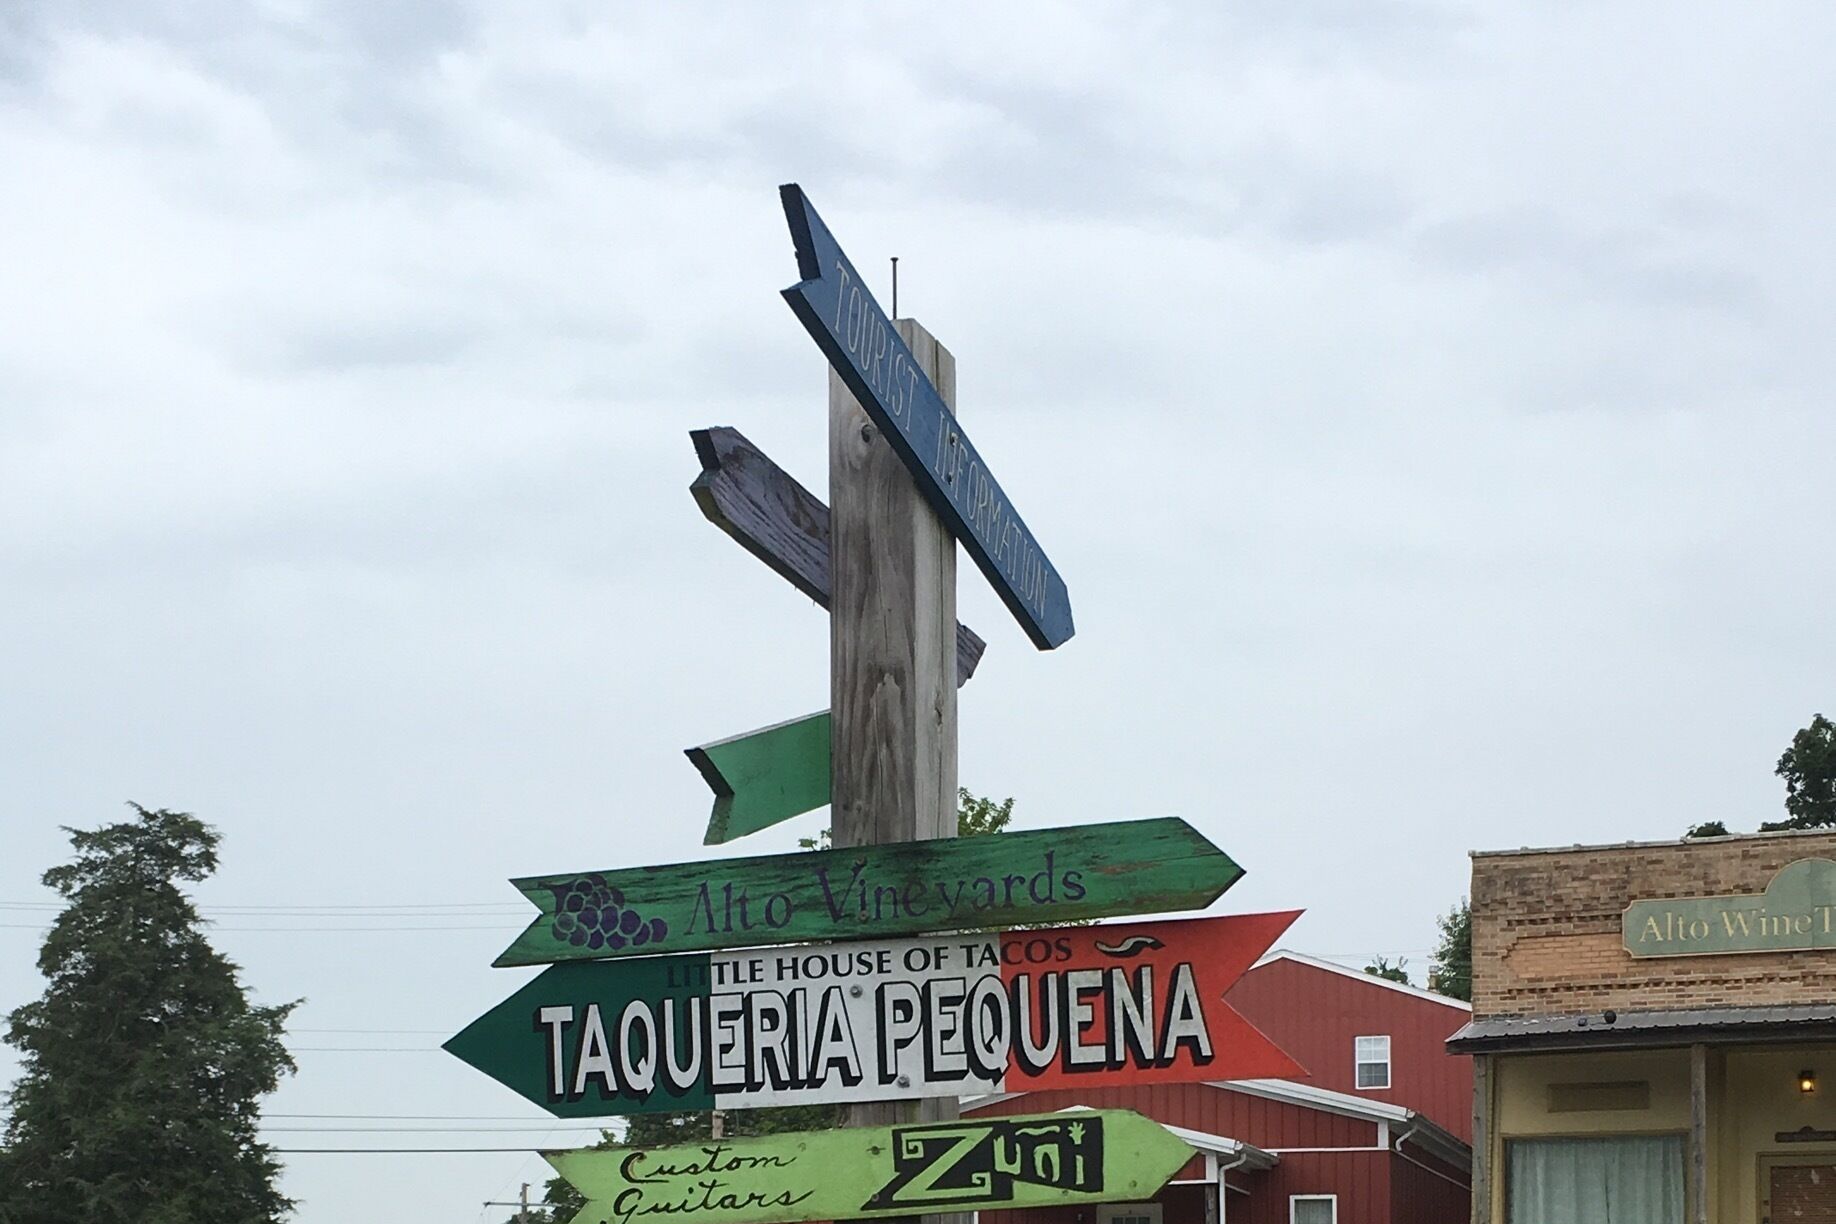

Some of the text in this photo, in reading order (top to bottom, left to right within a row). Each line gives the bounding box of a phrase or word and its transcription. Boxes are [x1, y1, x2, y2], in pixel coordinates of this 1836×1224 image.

[834, 261, 919, 432] TOURIST
[935, 411, 1048, 619] INFORMATION
[683, 849, 1087, 936] Alto Vineyards
[1640, 911, 1709, 943] Alto
[1721, 907, 1812, 938] Wine
[667, 937, 1072, 989] LITTLE HOUSE OF TACOS
[534, 962, 1215, 1104] TAQUERIA PEQUENA
[619, 1145, 797, 1183] Custom
